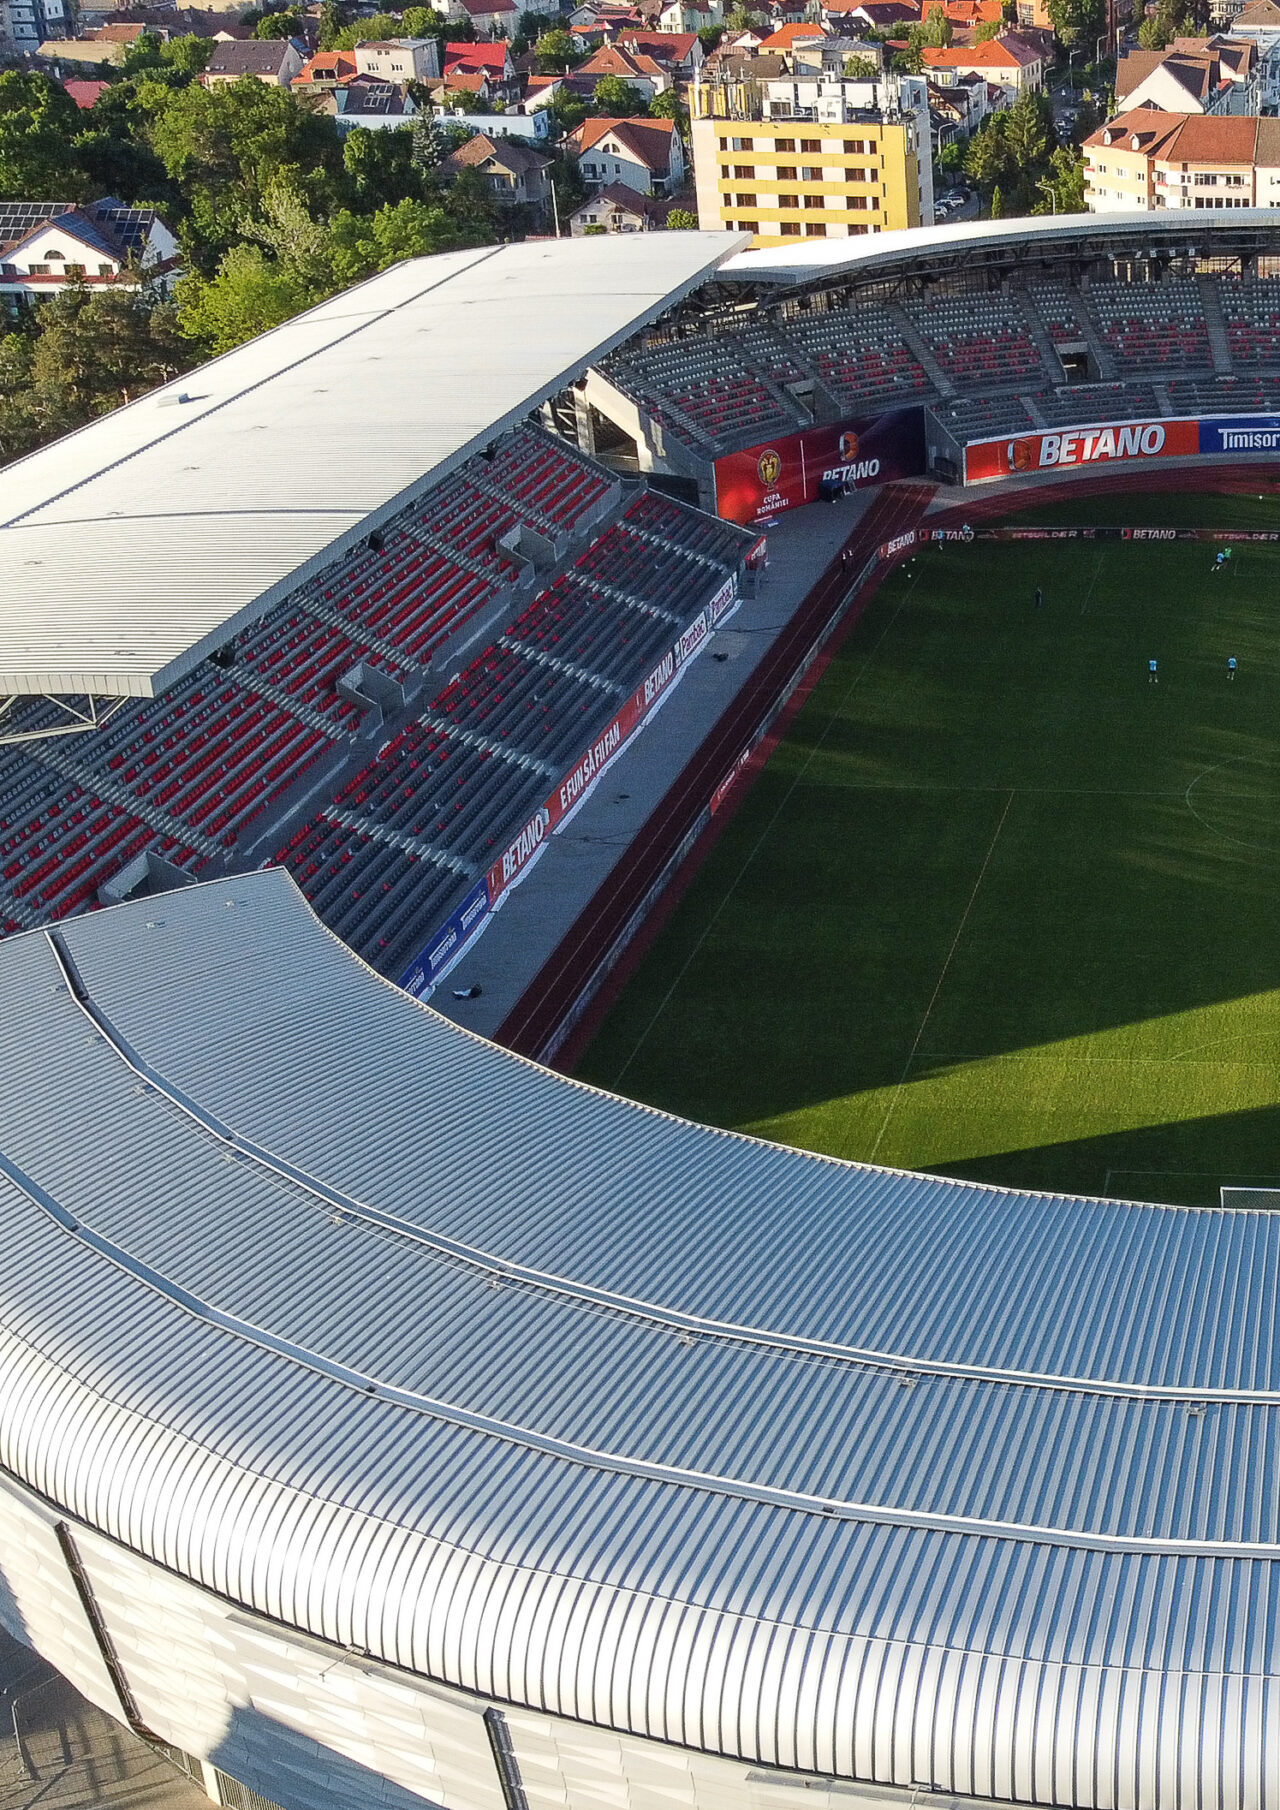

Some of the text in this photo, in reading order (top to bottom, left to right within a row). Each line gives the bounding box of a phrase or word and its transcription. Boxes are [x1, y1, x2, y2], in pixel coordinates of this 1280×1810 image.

[1039, 425, 1165, 467] BETANO
[823, 458, 880, 482] BETANO
[763, 493, 781, 504] CUPA
[887, 531, 915, 549] BETANO
[1133, 530, 1176, 540] BETANO
[644, 651, 673, 706] BETANO
[560, 786, 568, 810] E
[566, 766, 584, 804] FUN
[604, 721, 620, 756] FAN
[502, 814, 544, 883] BETANO
